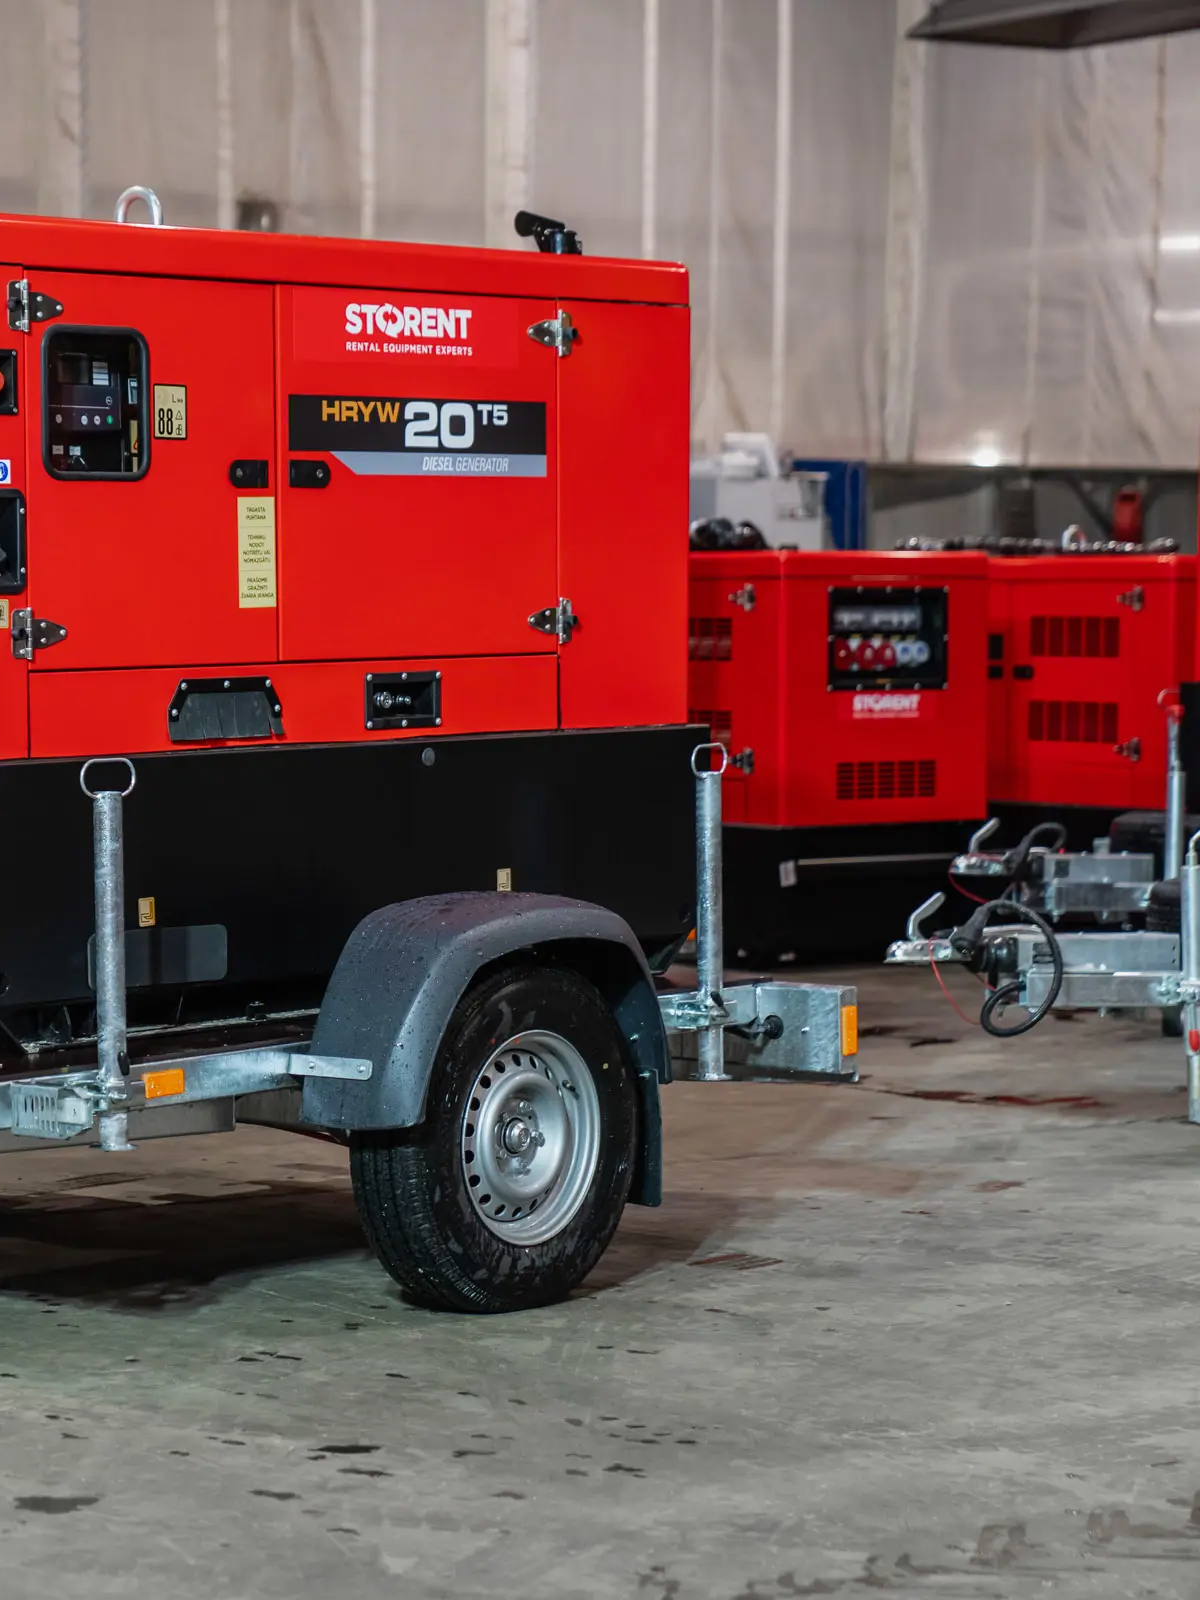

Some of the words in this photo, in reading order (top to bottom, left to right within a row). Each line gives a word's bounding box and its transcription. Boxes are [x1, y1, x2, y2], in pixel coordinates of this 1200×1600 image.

[345, 302, 472, 339] STORENT
[346, 341, 380, 352] RENTAL
[383, 343, 433, 354] EQUIPMENT
[435, 345, 473, 356] EXPERTS
[158, 408, 173, 435] 88
[321, 400, 400, 423] HRYW
[404, 401, 475, 449] 20
[477, 404, 509, 426] T5
[422, 456, 454, 472] DIESEL
[455, 457, 509, 473] GENERATOR
